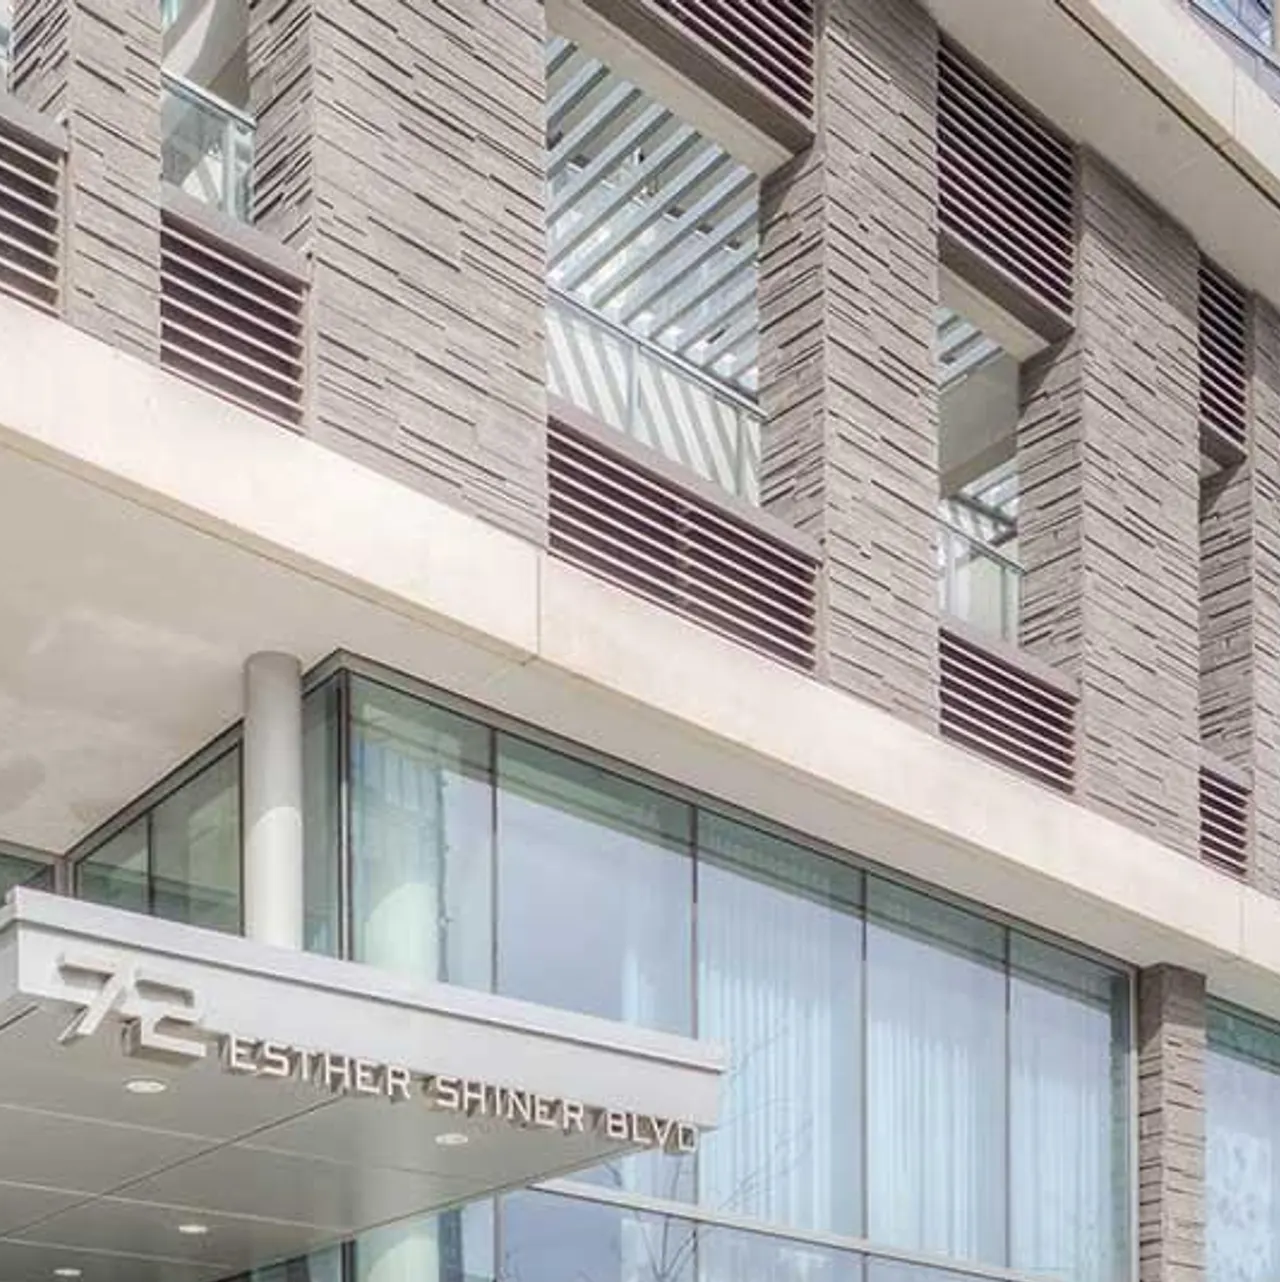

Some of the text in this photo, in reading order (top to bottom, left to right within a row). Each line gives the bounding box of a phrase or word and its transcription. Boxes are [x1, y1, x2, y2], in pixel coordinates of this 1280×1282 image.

[56, 953, 701, 1153] 72 ESTHER SHINER BLVD
